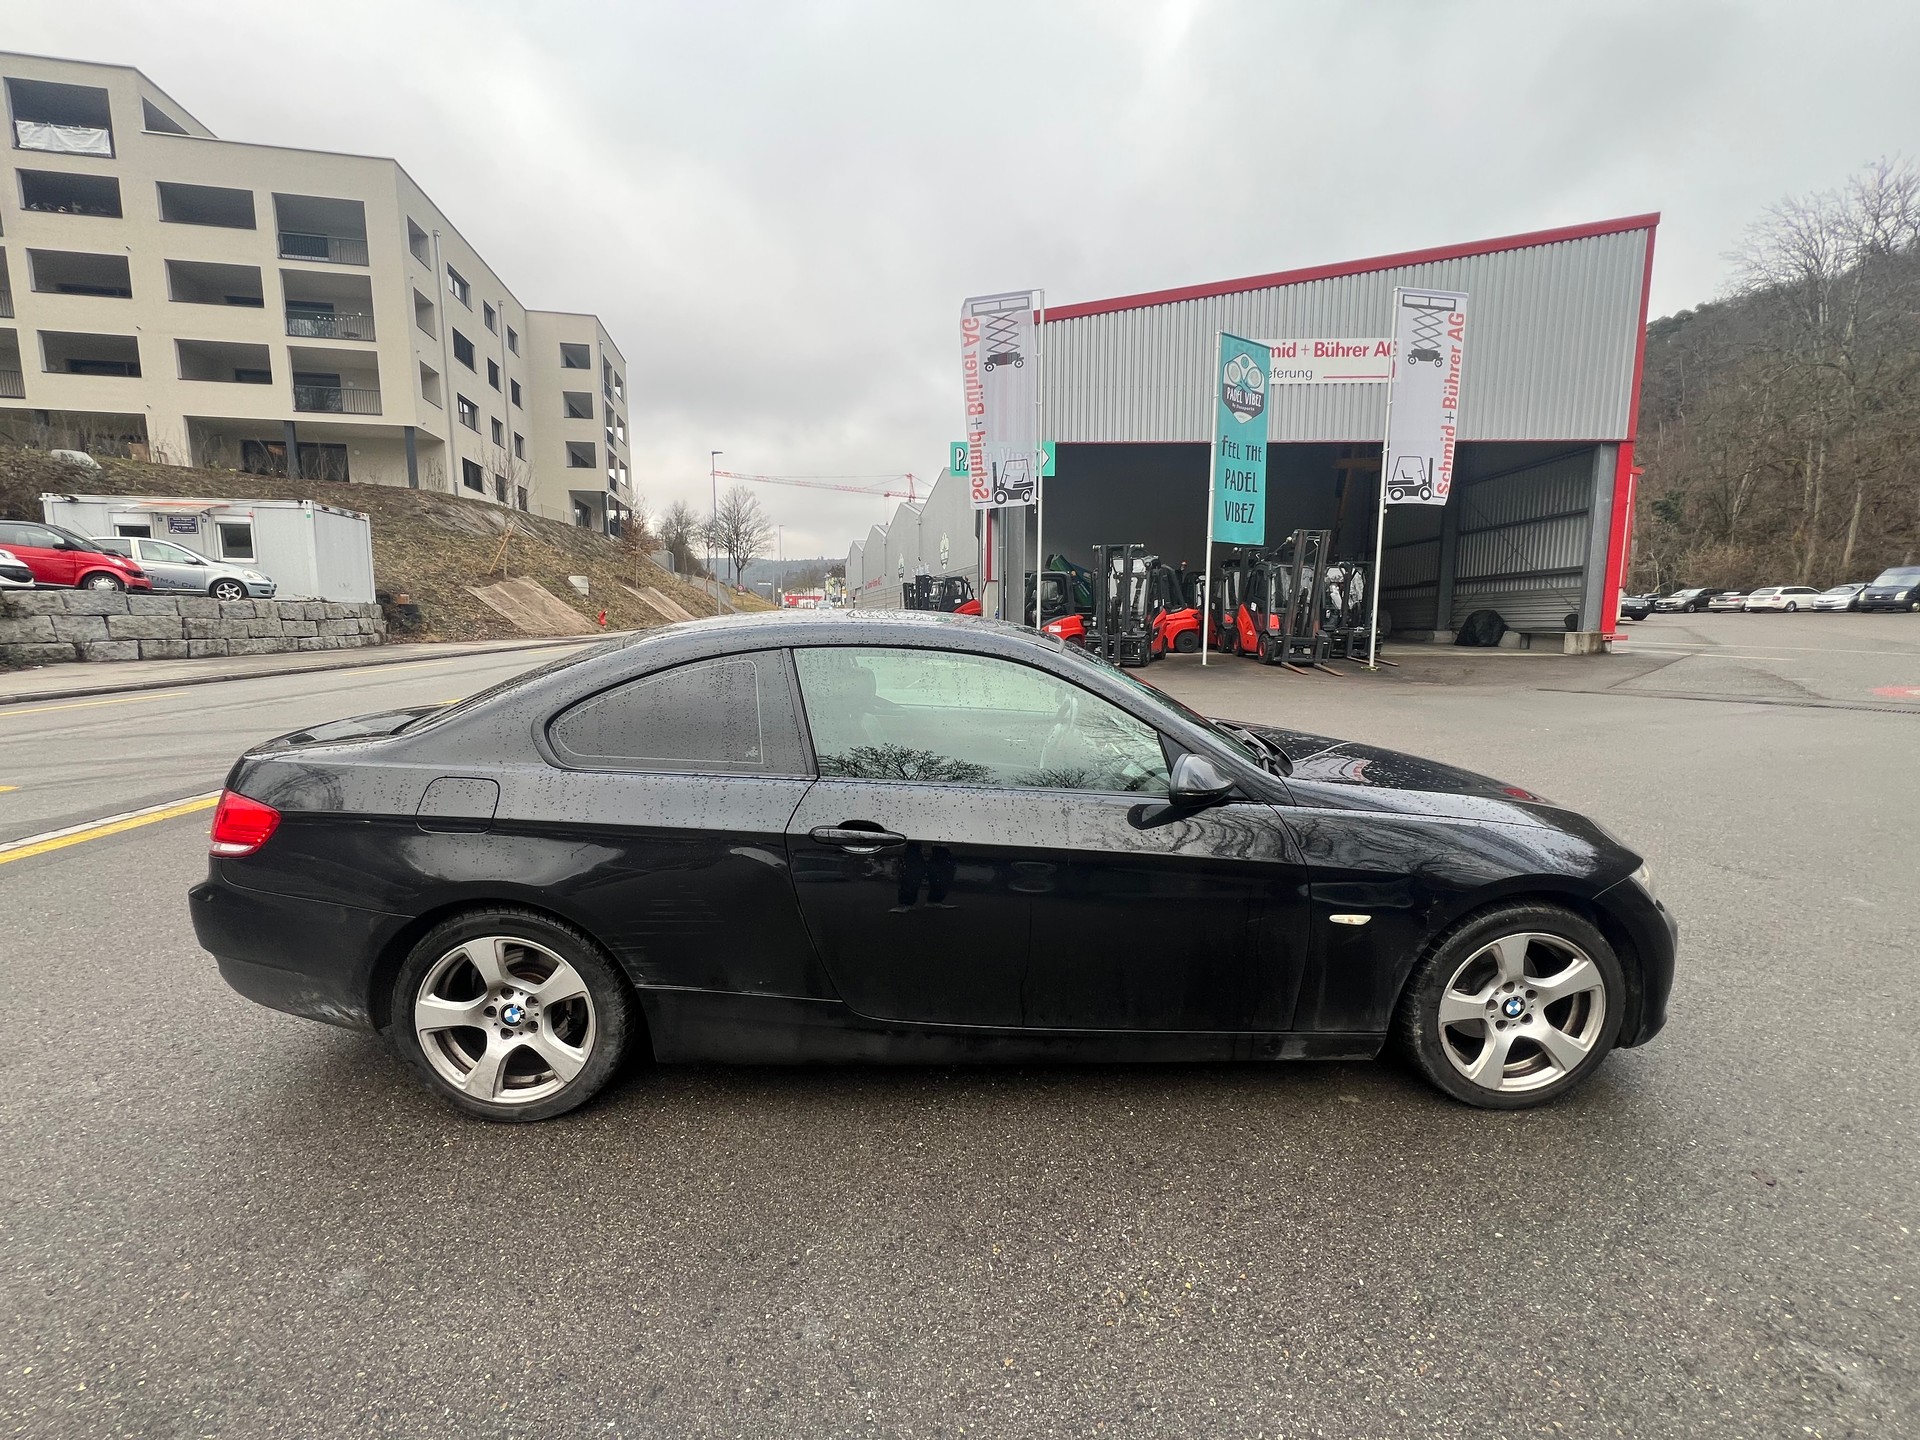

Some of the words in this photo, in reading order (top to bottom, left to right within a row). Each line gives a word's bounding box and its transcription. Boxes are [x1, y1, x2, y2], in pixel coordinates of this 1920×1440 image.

[1447, 312, 1465, 342] AG
[1314, 341, 1369, 358] Bührer
[1441, 345, 1462, 410] Bührer
[1226, 386, 1243, 404] PADEL
[1244, 392, 1262, 407] VIBEZ
[1436, 425, 1456, 495] Schmid
[1224, 468, 1258, 493] PADEL
[1224, 500, 1256, 524] VIBEZ
[147, 574, 197, 589] TIMA.CH
